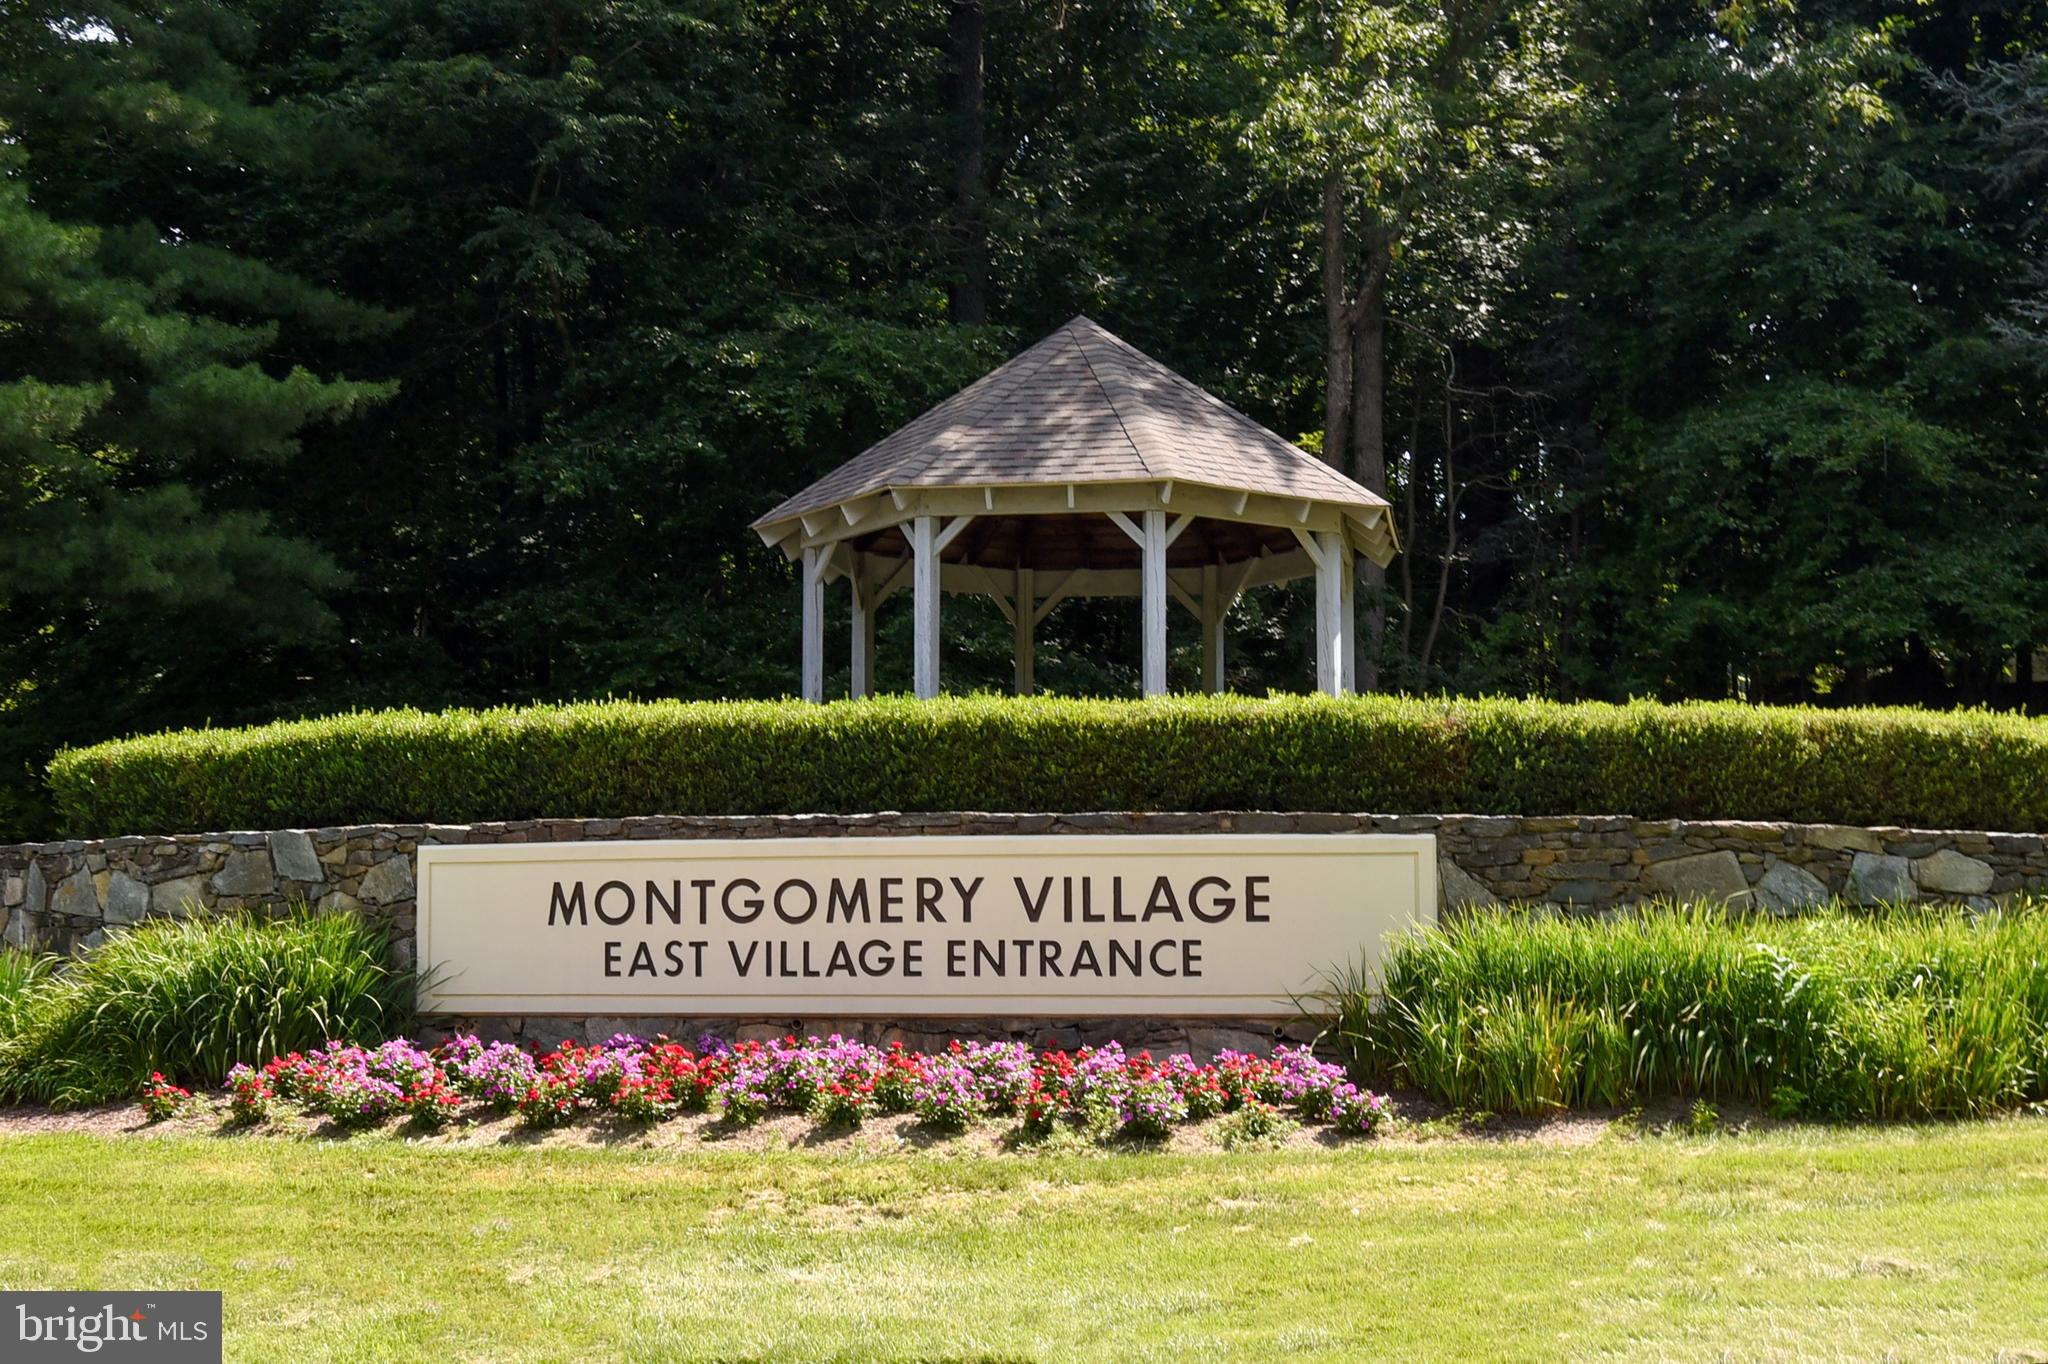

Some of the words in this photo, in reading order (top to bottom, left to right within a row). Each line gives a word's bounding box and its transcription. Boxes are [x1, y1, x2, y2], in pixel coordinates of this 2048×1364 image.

[547, 876, 985, 926] MONTGOMERY
[1013, 875, 1271, 924] VILLAGE
[604, 940, 709, 978] EAST
[727, 939, 923, 978] VILLAGE
[946, 938, 1203, 978] ENTRANCE
